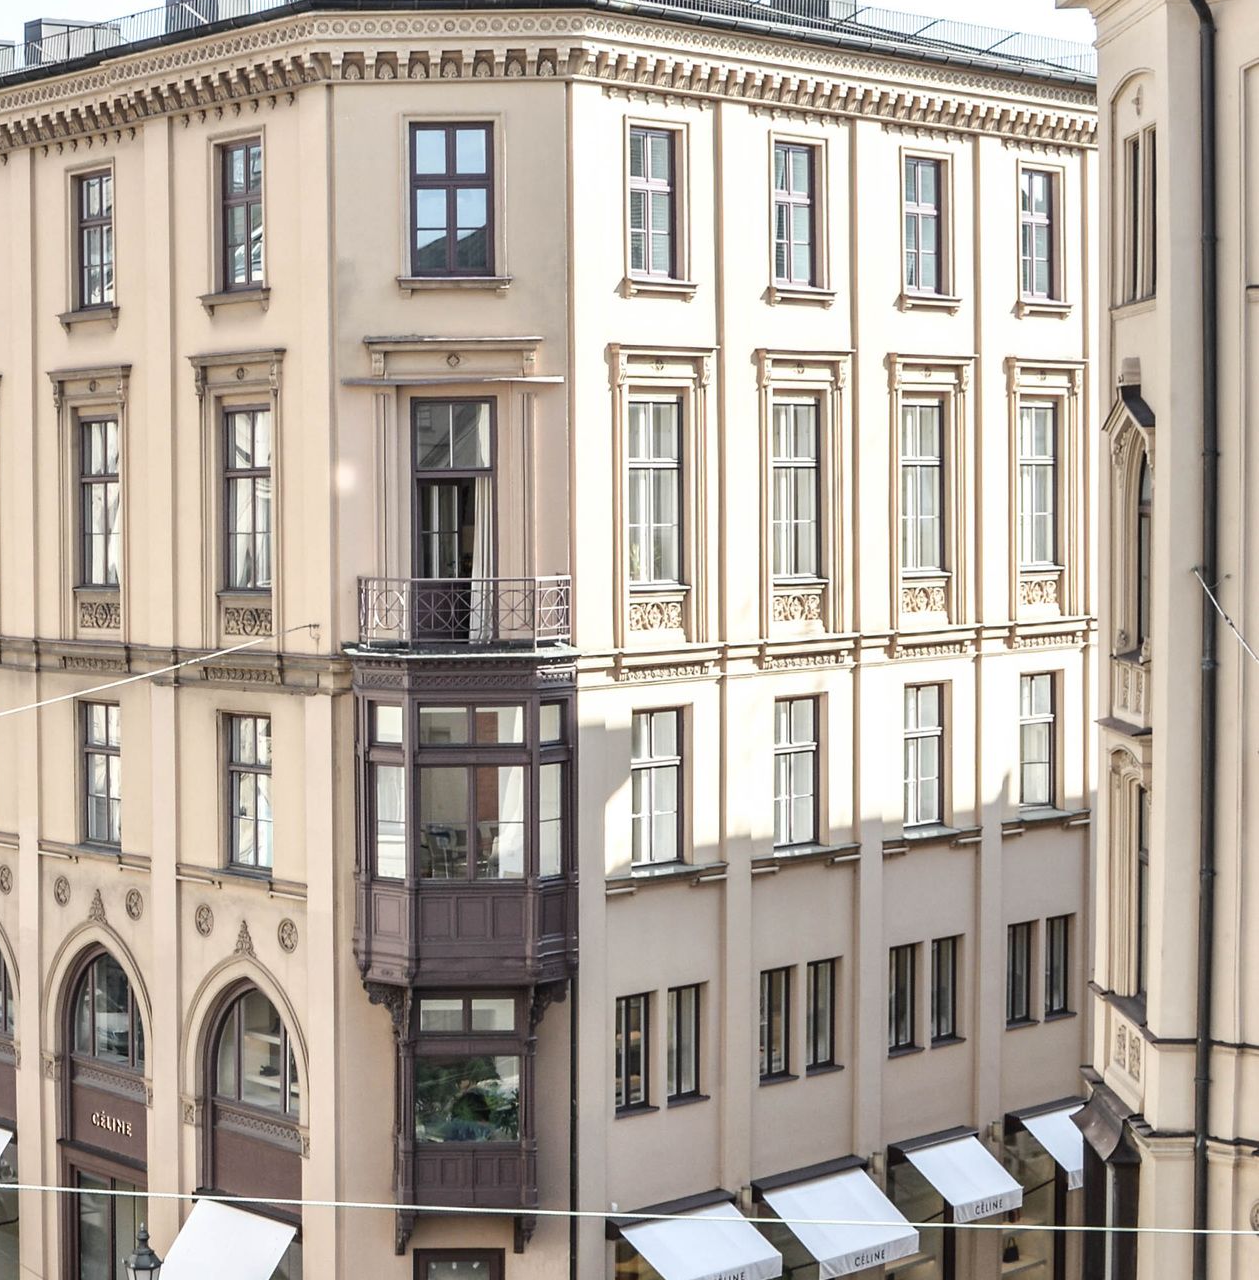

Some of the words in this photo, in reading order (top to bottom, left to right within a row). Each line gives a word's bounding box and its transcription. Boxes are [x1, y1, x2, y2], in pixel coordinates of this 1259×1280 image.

[91, 1110, 132, 1137] CÉLINE
[975, 1198, 1004, 1216] CÉLINE
[854, 1249, 885, 1267] CÉLINE
